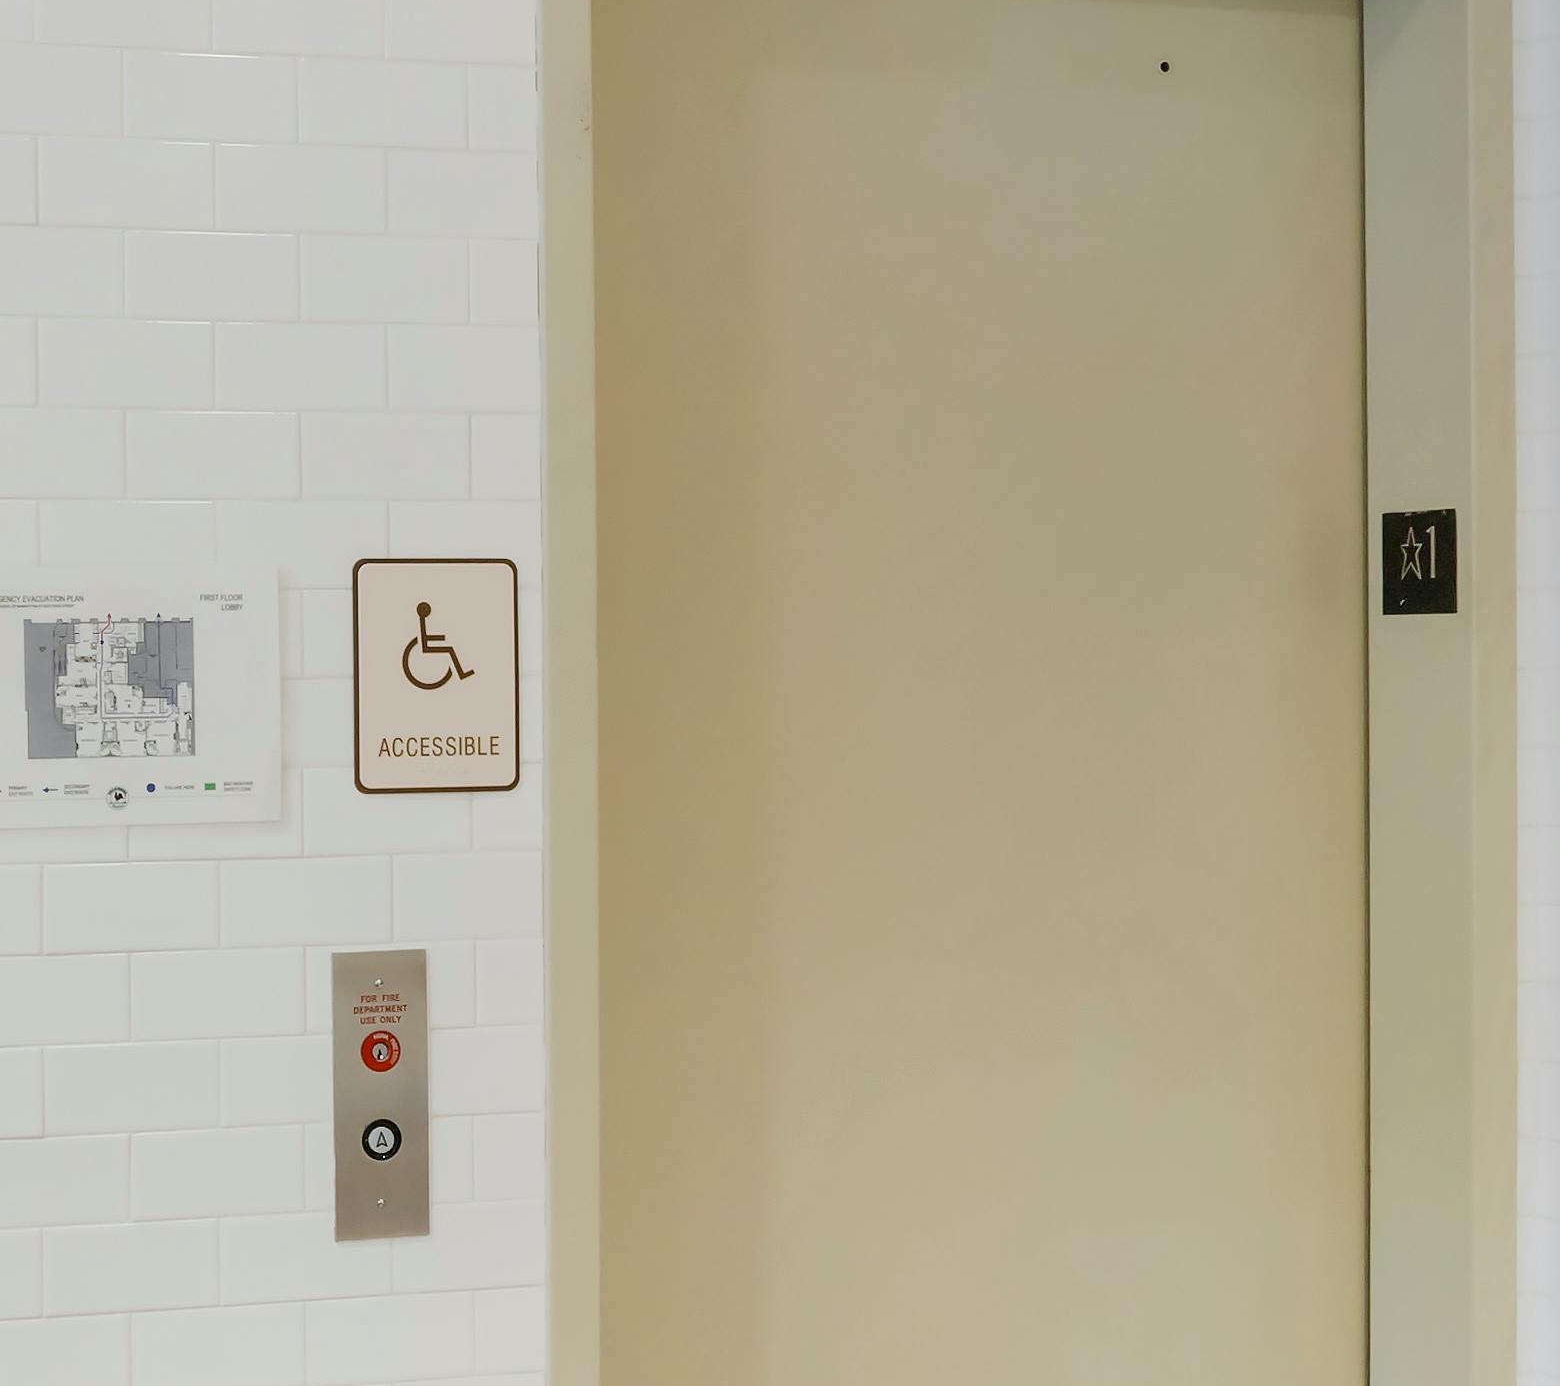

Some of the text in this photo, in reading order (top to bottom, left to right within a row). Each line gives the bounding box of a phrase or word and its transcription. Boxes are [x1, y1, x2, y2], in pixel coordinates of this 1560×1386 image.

[378, 735, 500, 758] ACCESSIBLE
[360, 993, 401, 1004] FOR FIRE
[353, 1004, 408, 1015] DEPARTMENT
[360, 1015, 402, 1025] USE ONLY
